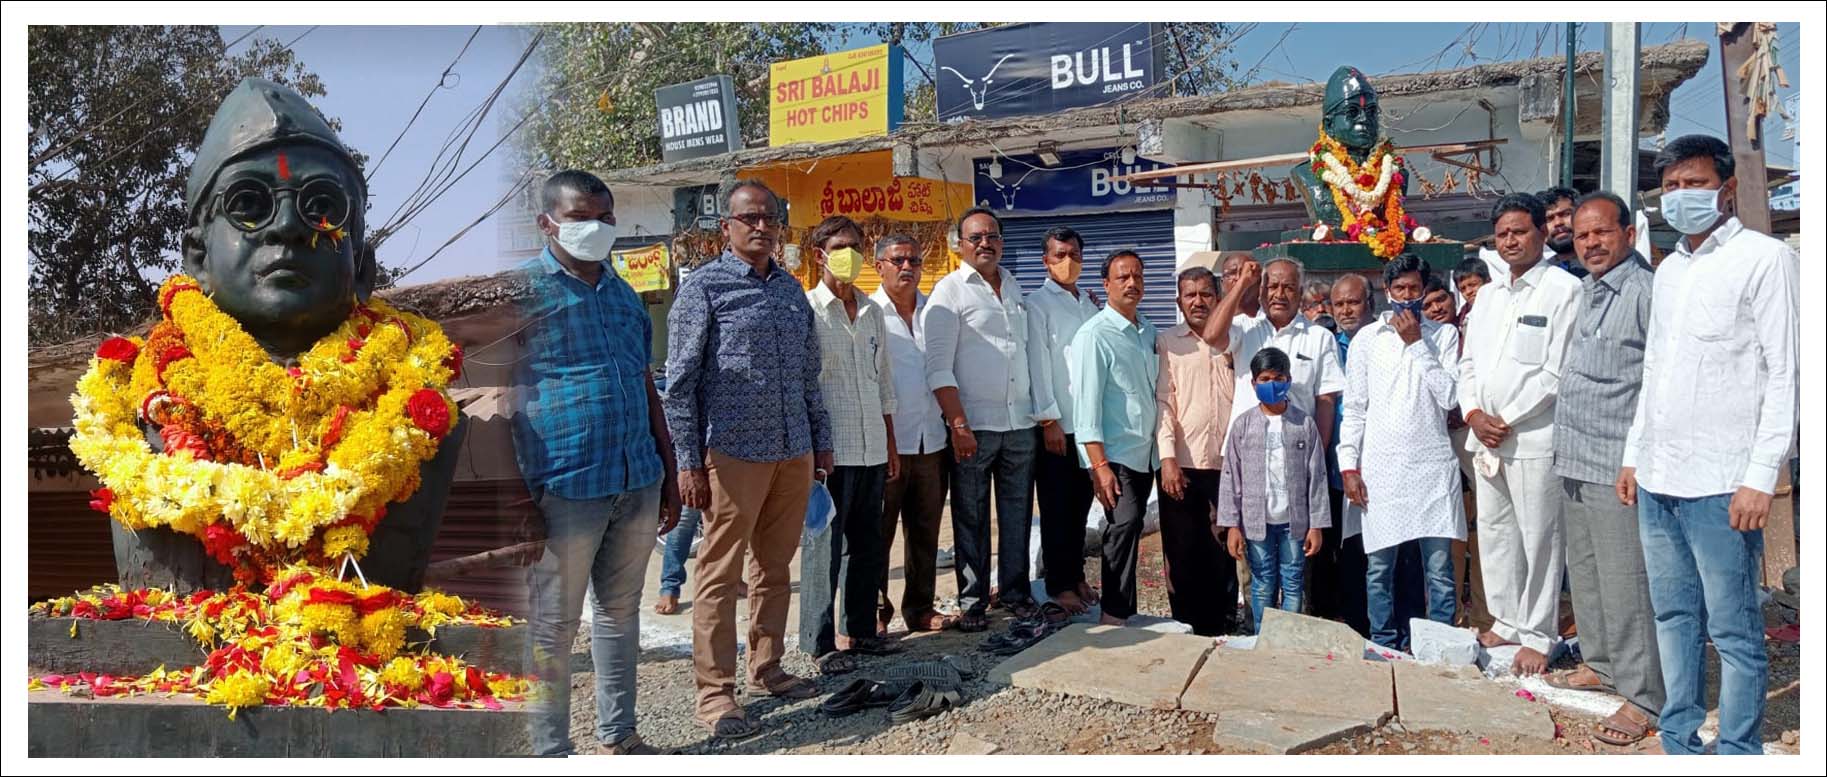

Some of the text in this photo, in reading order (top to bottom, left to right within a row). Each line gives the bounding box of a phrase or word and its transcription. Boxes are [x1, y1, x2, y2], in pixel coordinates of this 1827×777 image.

[1051, 43, 1144, 90] BULL
[776, 67, 880, 103] SRI BALAJI
[1103, 80, 1145, 94] JEANS CO.
[661, 99, 722, 138] BRAND
[786, 101, 869, 128] HOT CHIPS
[686, 136, 704, 148] MENS
[705, 134, 724, 145] WEAR
[1091, 163, 1169, 197] BULL
